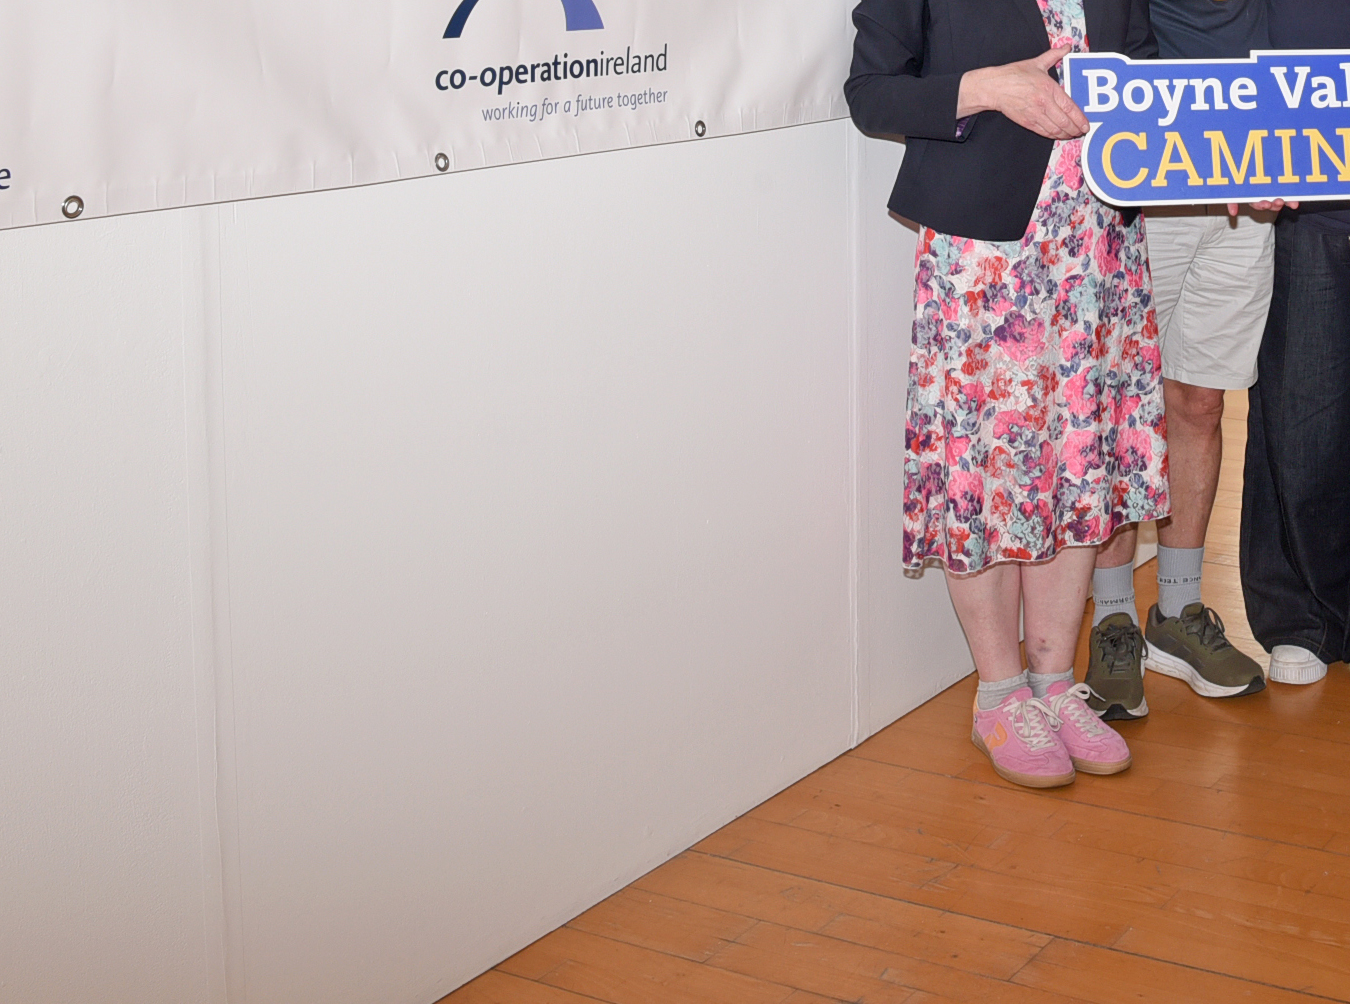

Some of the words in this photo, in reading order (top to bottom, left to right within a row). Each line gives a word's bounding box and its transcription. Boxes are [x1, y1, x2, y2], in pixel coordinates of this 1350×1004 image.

[482, 101, 538, 122] working
[539, 98, 560, 121] for
[563, 98, 572, 113] a
[574, 94, 614, 117] future
[617, 87, 668, 110] together
[1082, 69, 1257, 126] Boyne
